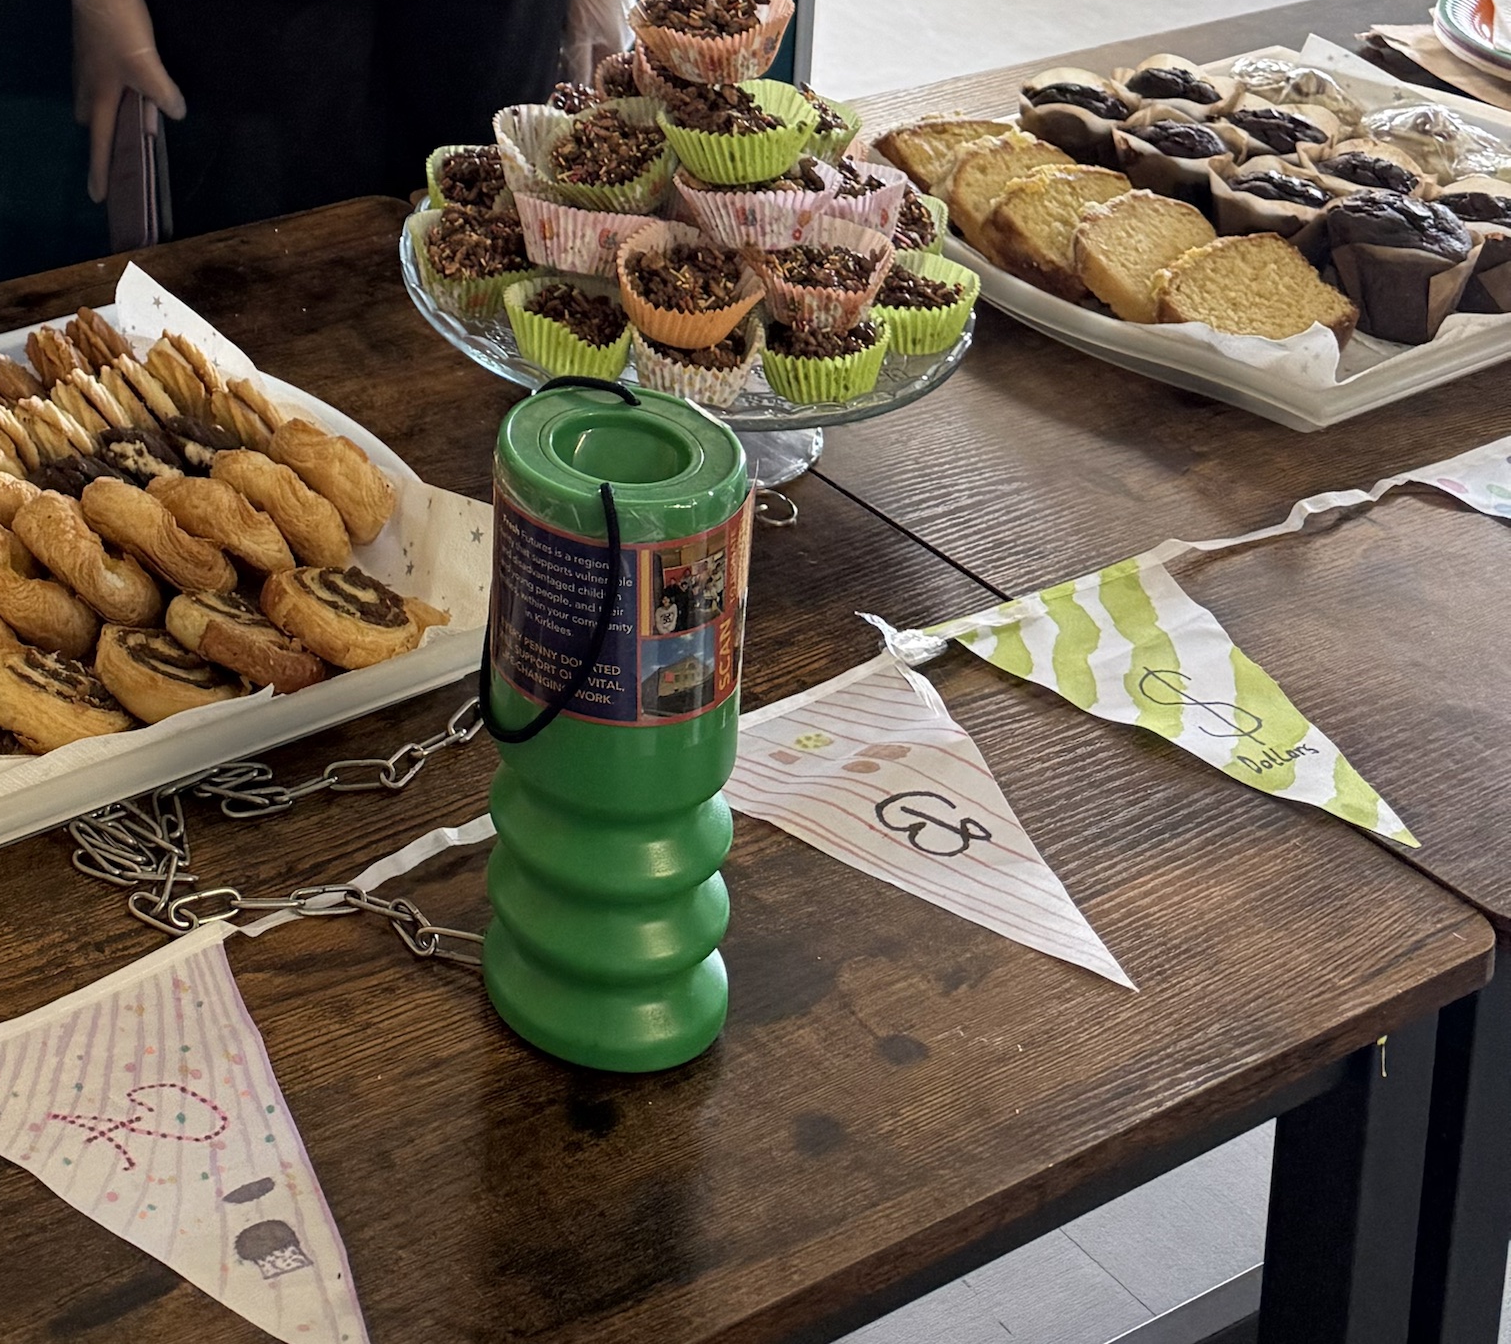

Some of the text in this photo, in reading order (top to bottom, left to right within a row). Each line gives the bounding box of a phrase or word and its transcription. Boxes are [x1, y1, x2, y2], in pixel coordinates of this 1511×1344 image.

[521, 531, 553, 555] Futures
[555, 547, 562, 558] is
[565, 553, 571, 562] a
[574, 555, 610, 570] region
[513, 554, 576, 593] disadvantaged
[532, 552, 573, 577] supports
[575, 570, 633, 588] vulnerle
[534, 613, 572, 637] Kirklees.
[547, 604, 569, 621] your
[575, 601, 596, 613] and
[514, 644, 557, 675] SUPPORT
[524, 637, 558, 660] PENNY
[560, 653, 622, 676] DOTED
[718, 618, 732, 691] SCAN
